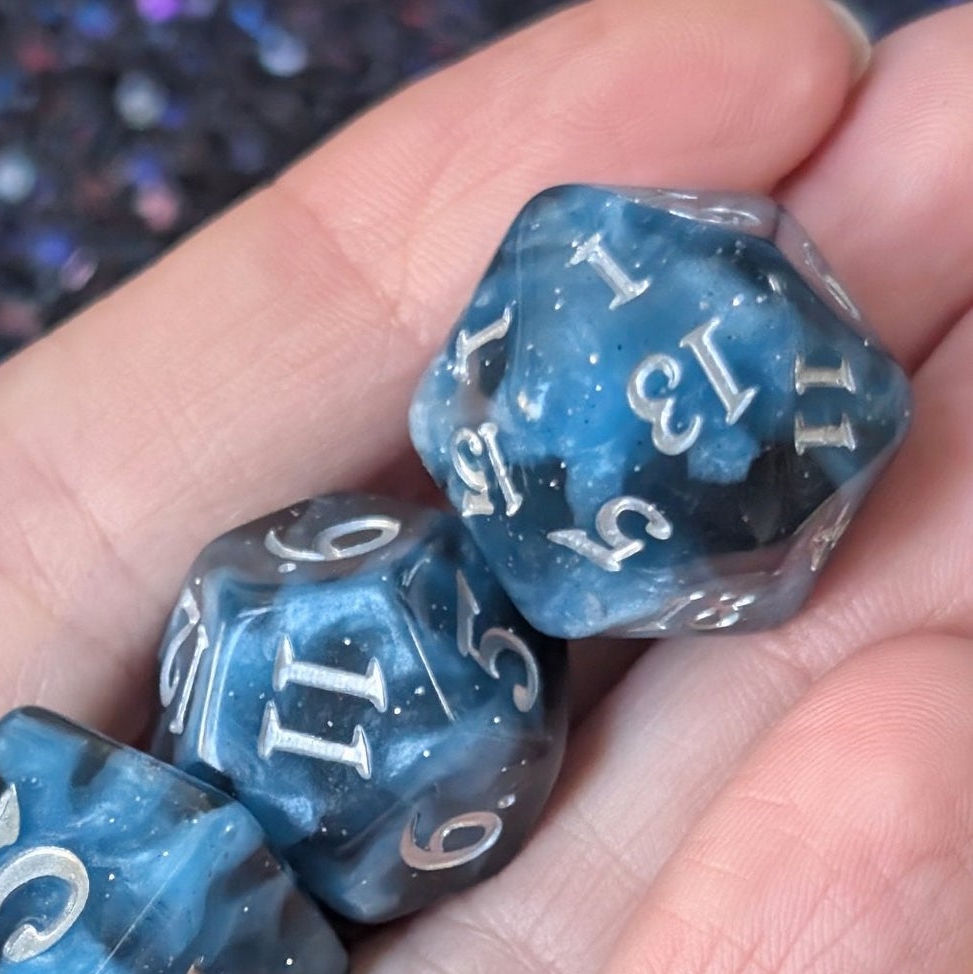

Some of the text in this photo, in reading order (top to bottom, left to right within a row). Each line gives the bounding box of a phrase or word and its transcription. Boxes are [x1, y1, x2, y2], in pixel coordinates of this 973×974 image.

[566, 233, 650, 309] 1
[628, 318, 757, 456] 13
[794, 353, 856, 457] 11
[451, 422, 523, 518] 15
[547, 496, 673, 572] 5
[456, 569, 540, 712] 5
[258, 634, 387, 779] 11
